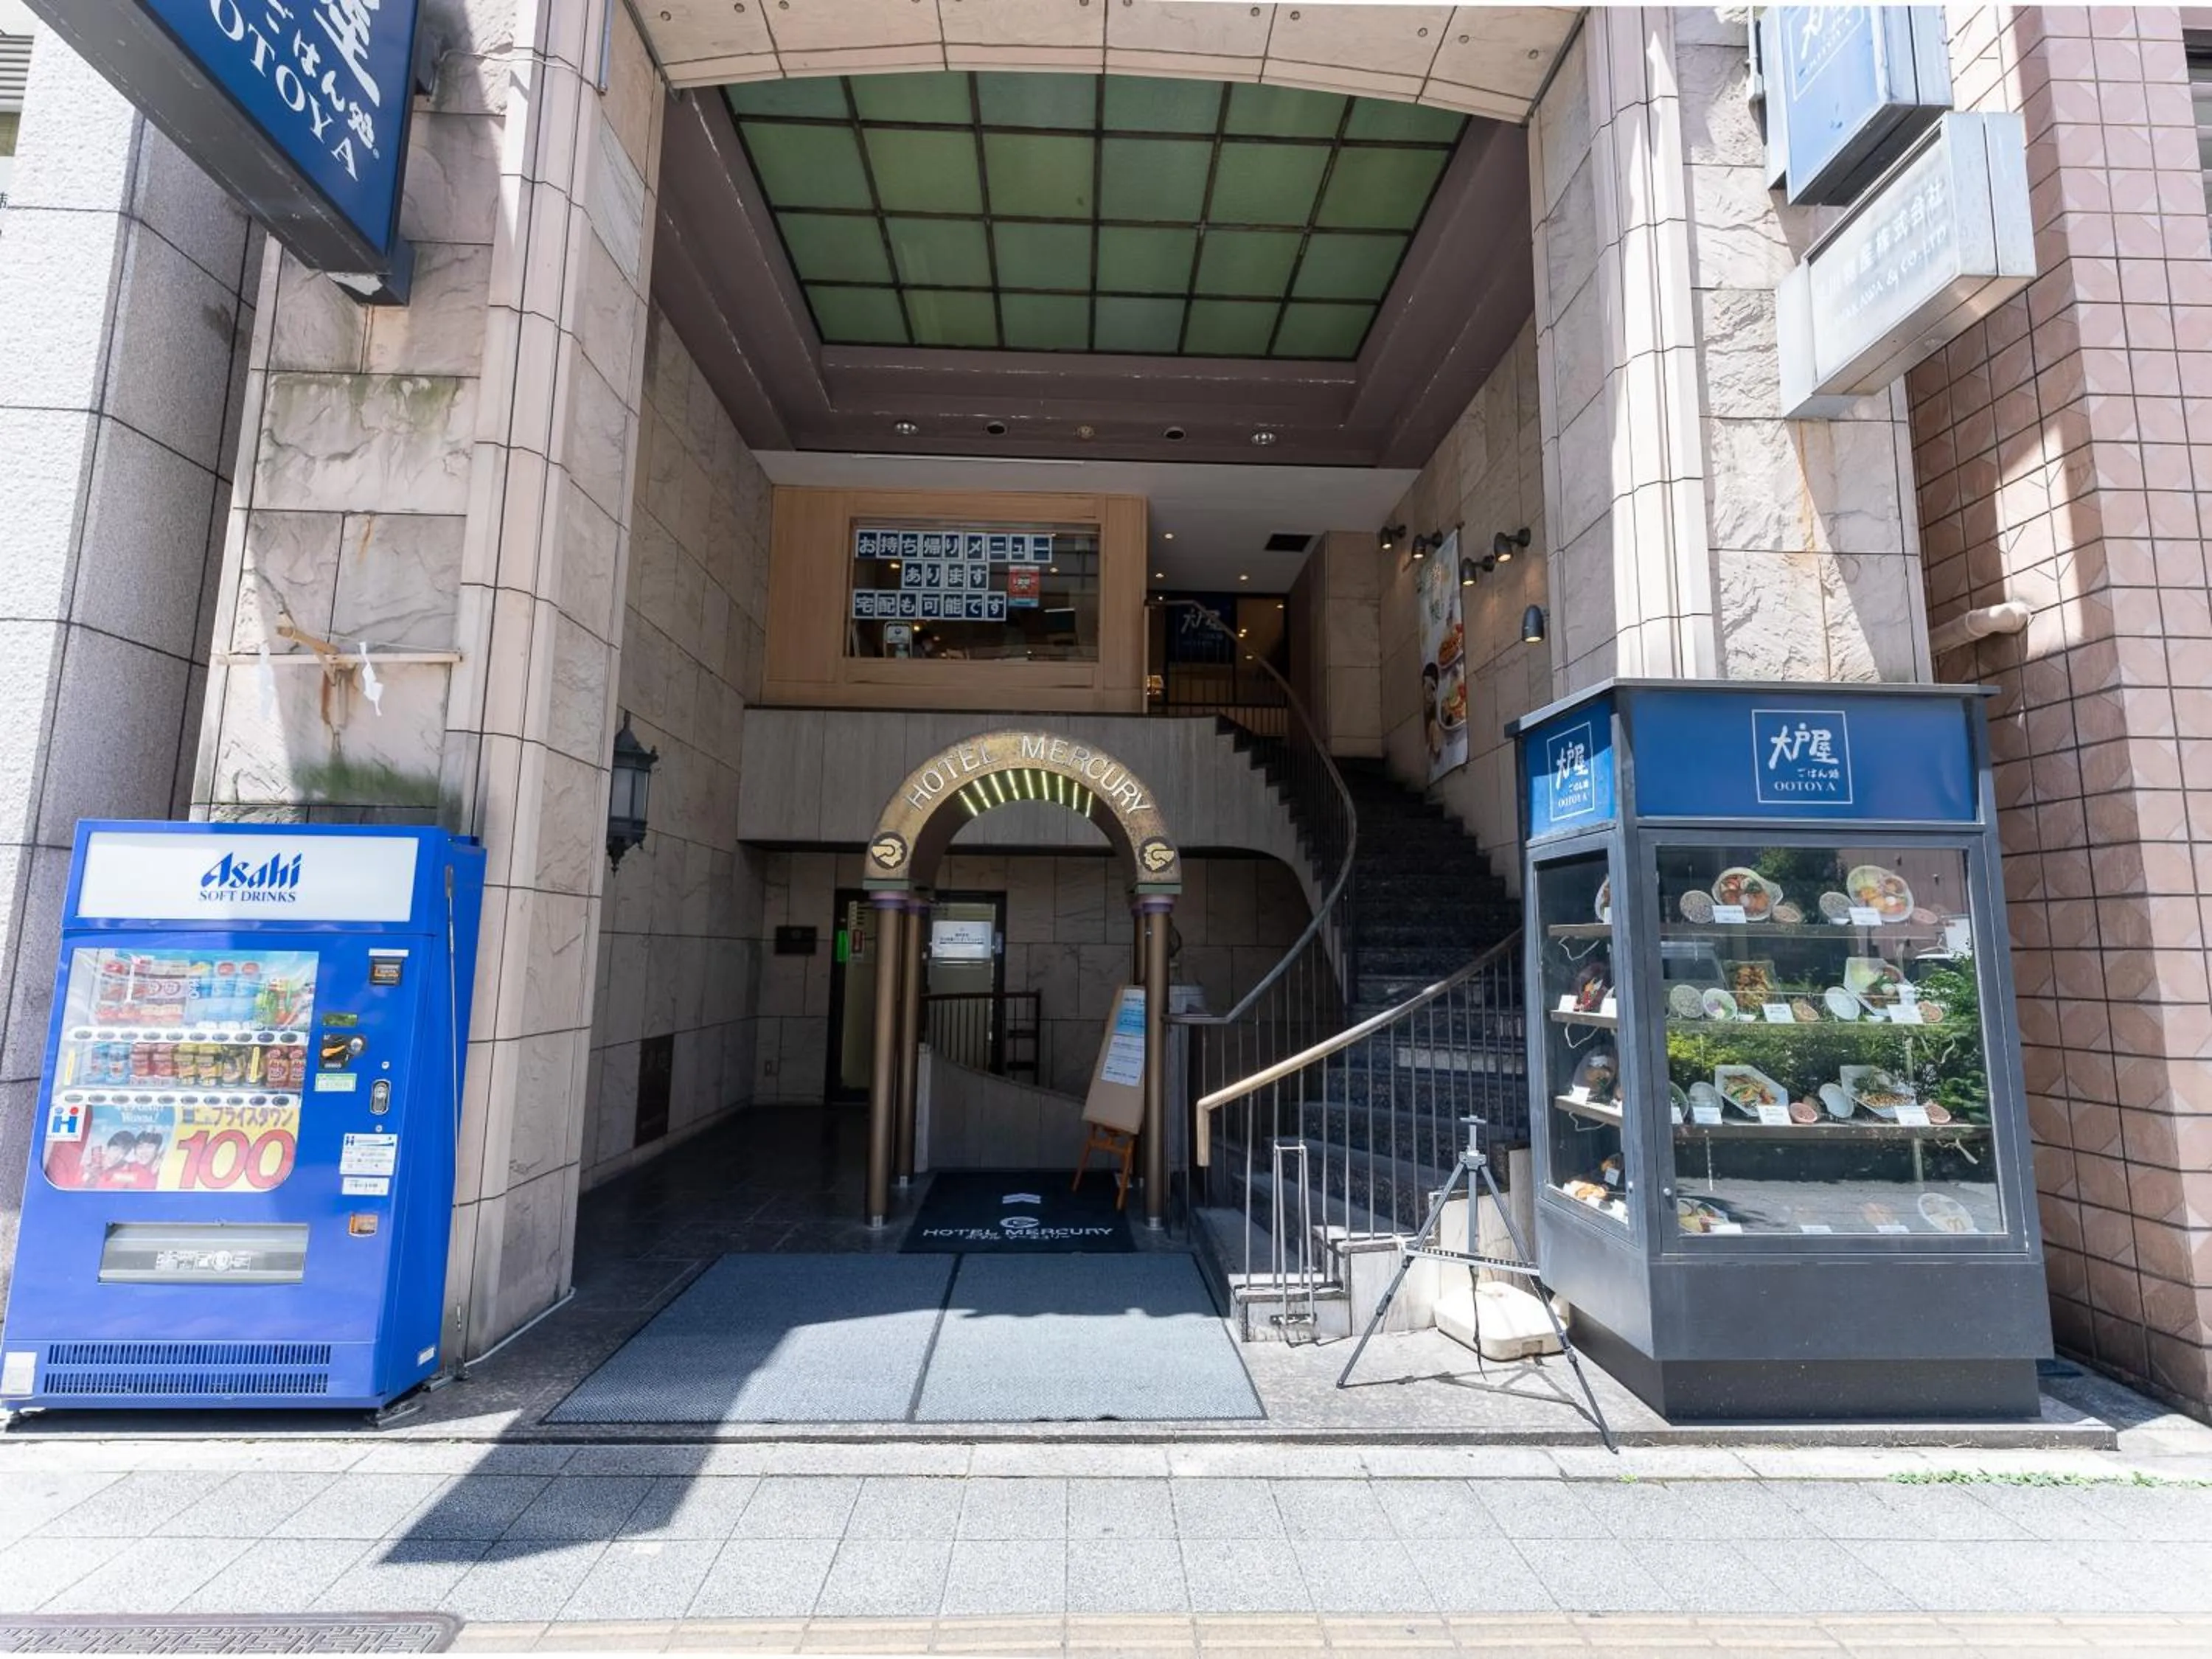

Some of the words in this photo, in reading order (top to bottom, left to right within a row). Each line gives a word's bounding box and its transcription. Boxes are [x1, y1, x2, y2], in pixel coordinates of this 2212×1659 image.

[858, 534, 1049, 558] お持ち帰りメニュー
[905, 566, 987, 586] あります
[855, 594, 1004, 616] 宅配も可能です
[1768, 723, 1839, 770] 大戸屋
[905, 742, 998, 810] HOTEL
[1021, 735, 1150, 814] MERCURY
[1556, 741, 1589, 790] 大戸屋
[1774, 781, 1836, 792] OOTOYA
[201, 852, 302, 889] Asahi
[199, 890, 236, 902] SOFT
[240, 890, 296, 903] DRINKS
[177, 1129, 296, 1189] 100
[922, 1228, 997, 1237] HOTEL
[1005, 1227, 1113, 1237] MERCURY
